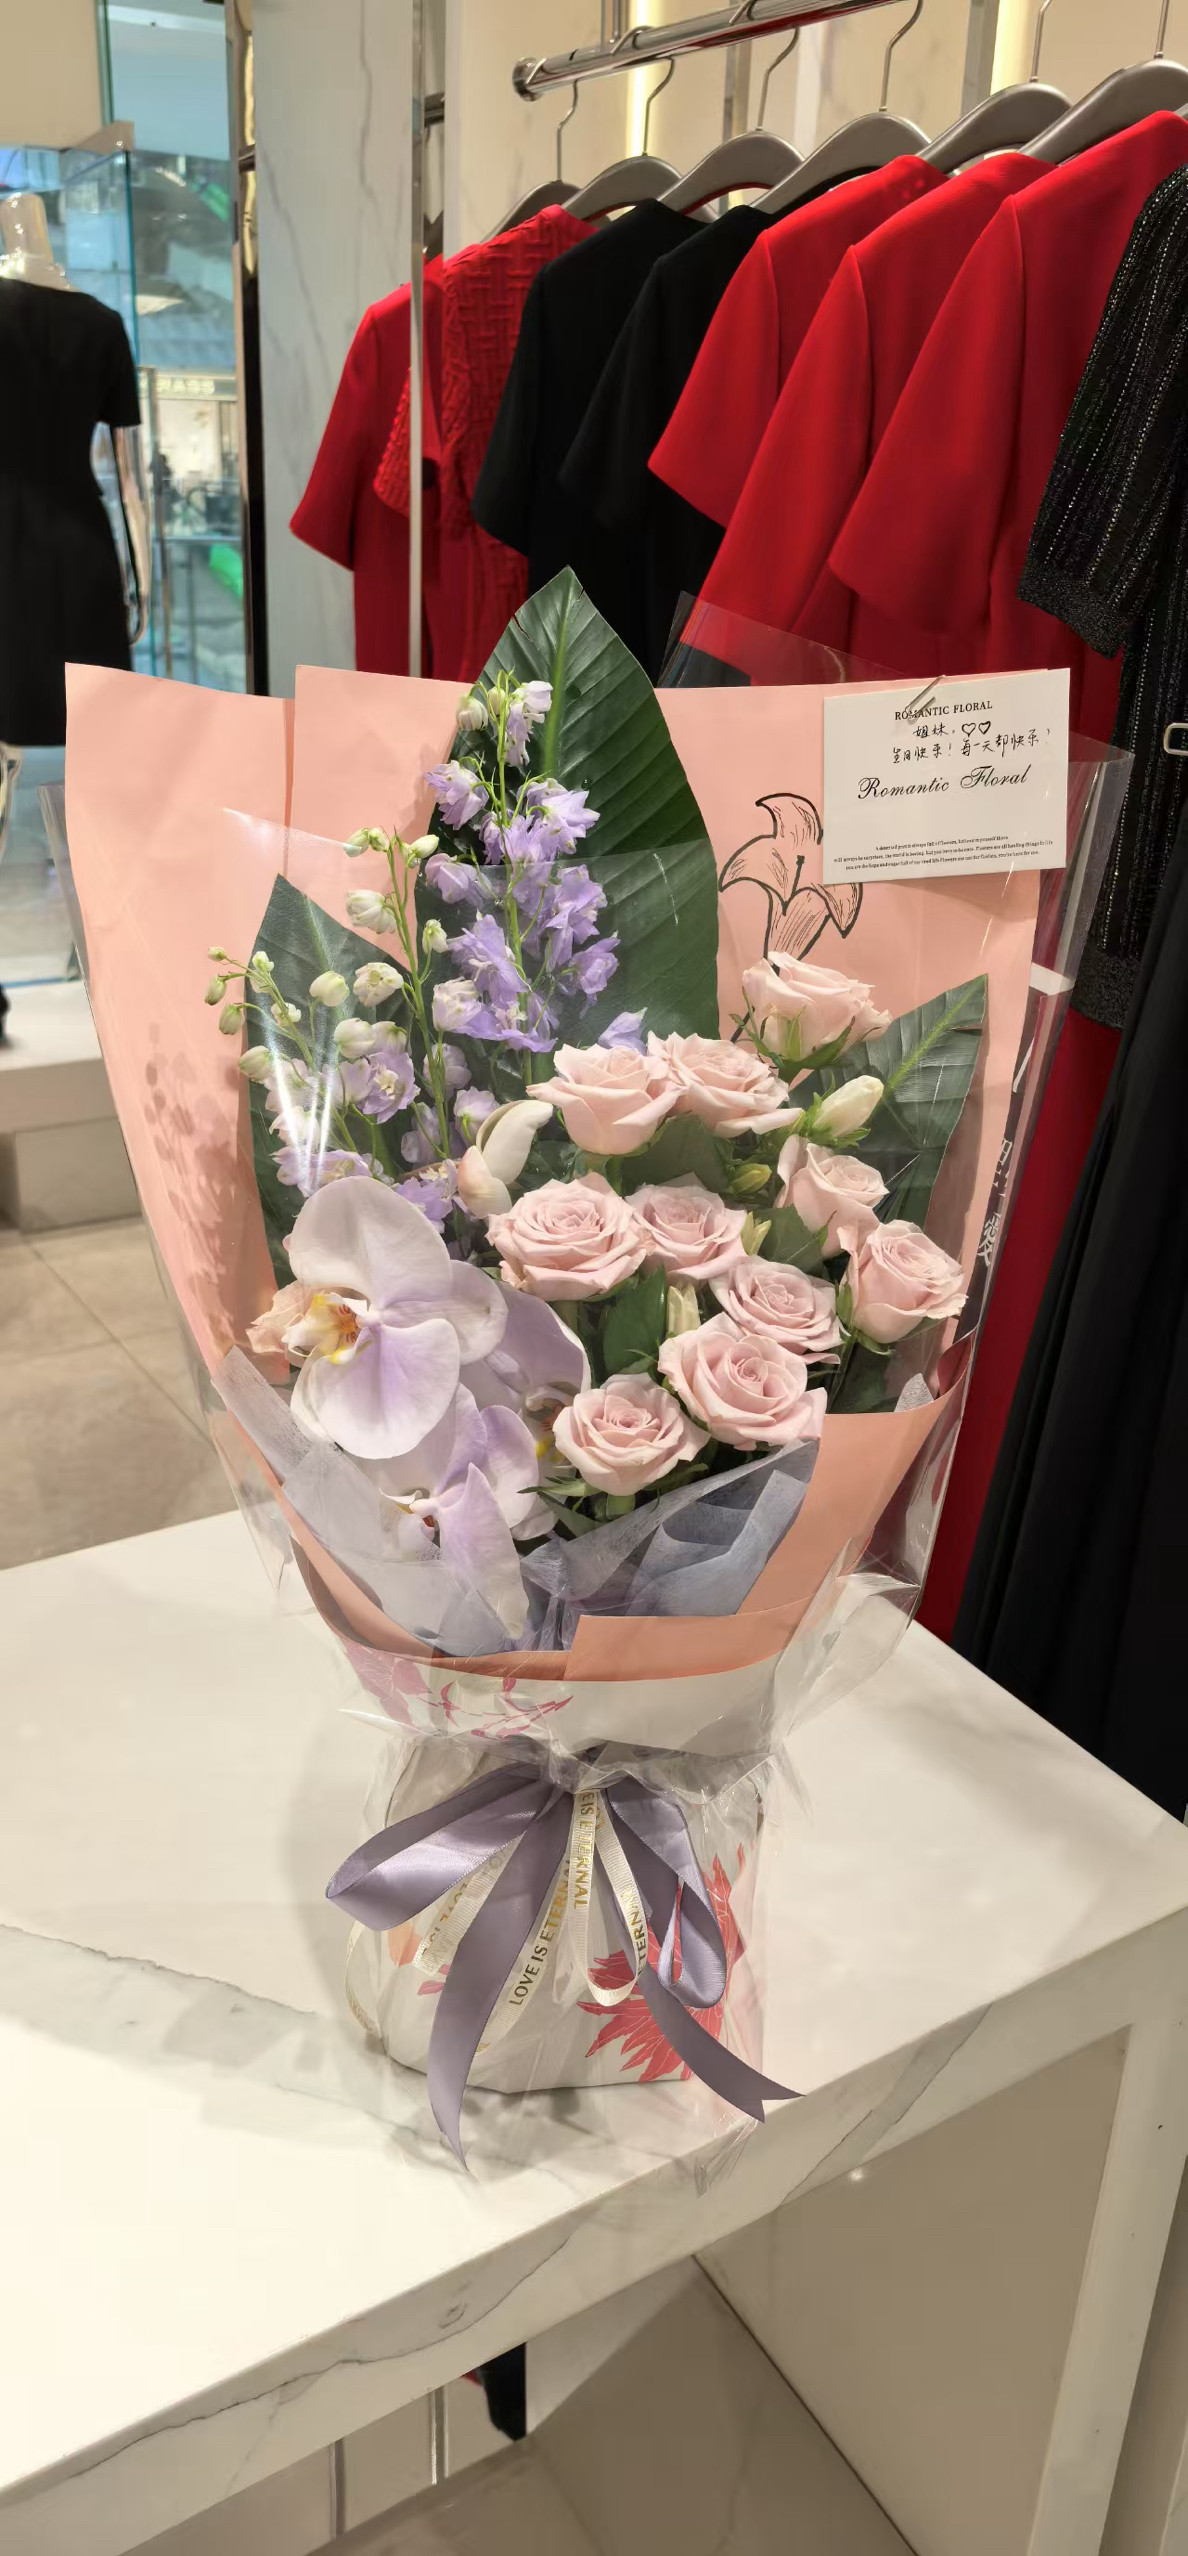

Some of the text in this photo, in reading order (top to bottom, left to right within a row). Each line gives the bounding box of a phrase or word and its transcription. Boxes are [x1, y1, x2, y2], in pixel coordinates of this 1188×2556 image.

[895, 700, 993, 721] ROMANTIC FLORAL
[858, 764, 1032, 799] Romantic Floral
[574, 1820, 592, 1910] ETERNAL
[509, 1858, 570, 2006] LOVE IS ETERN
